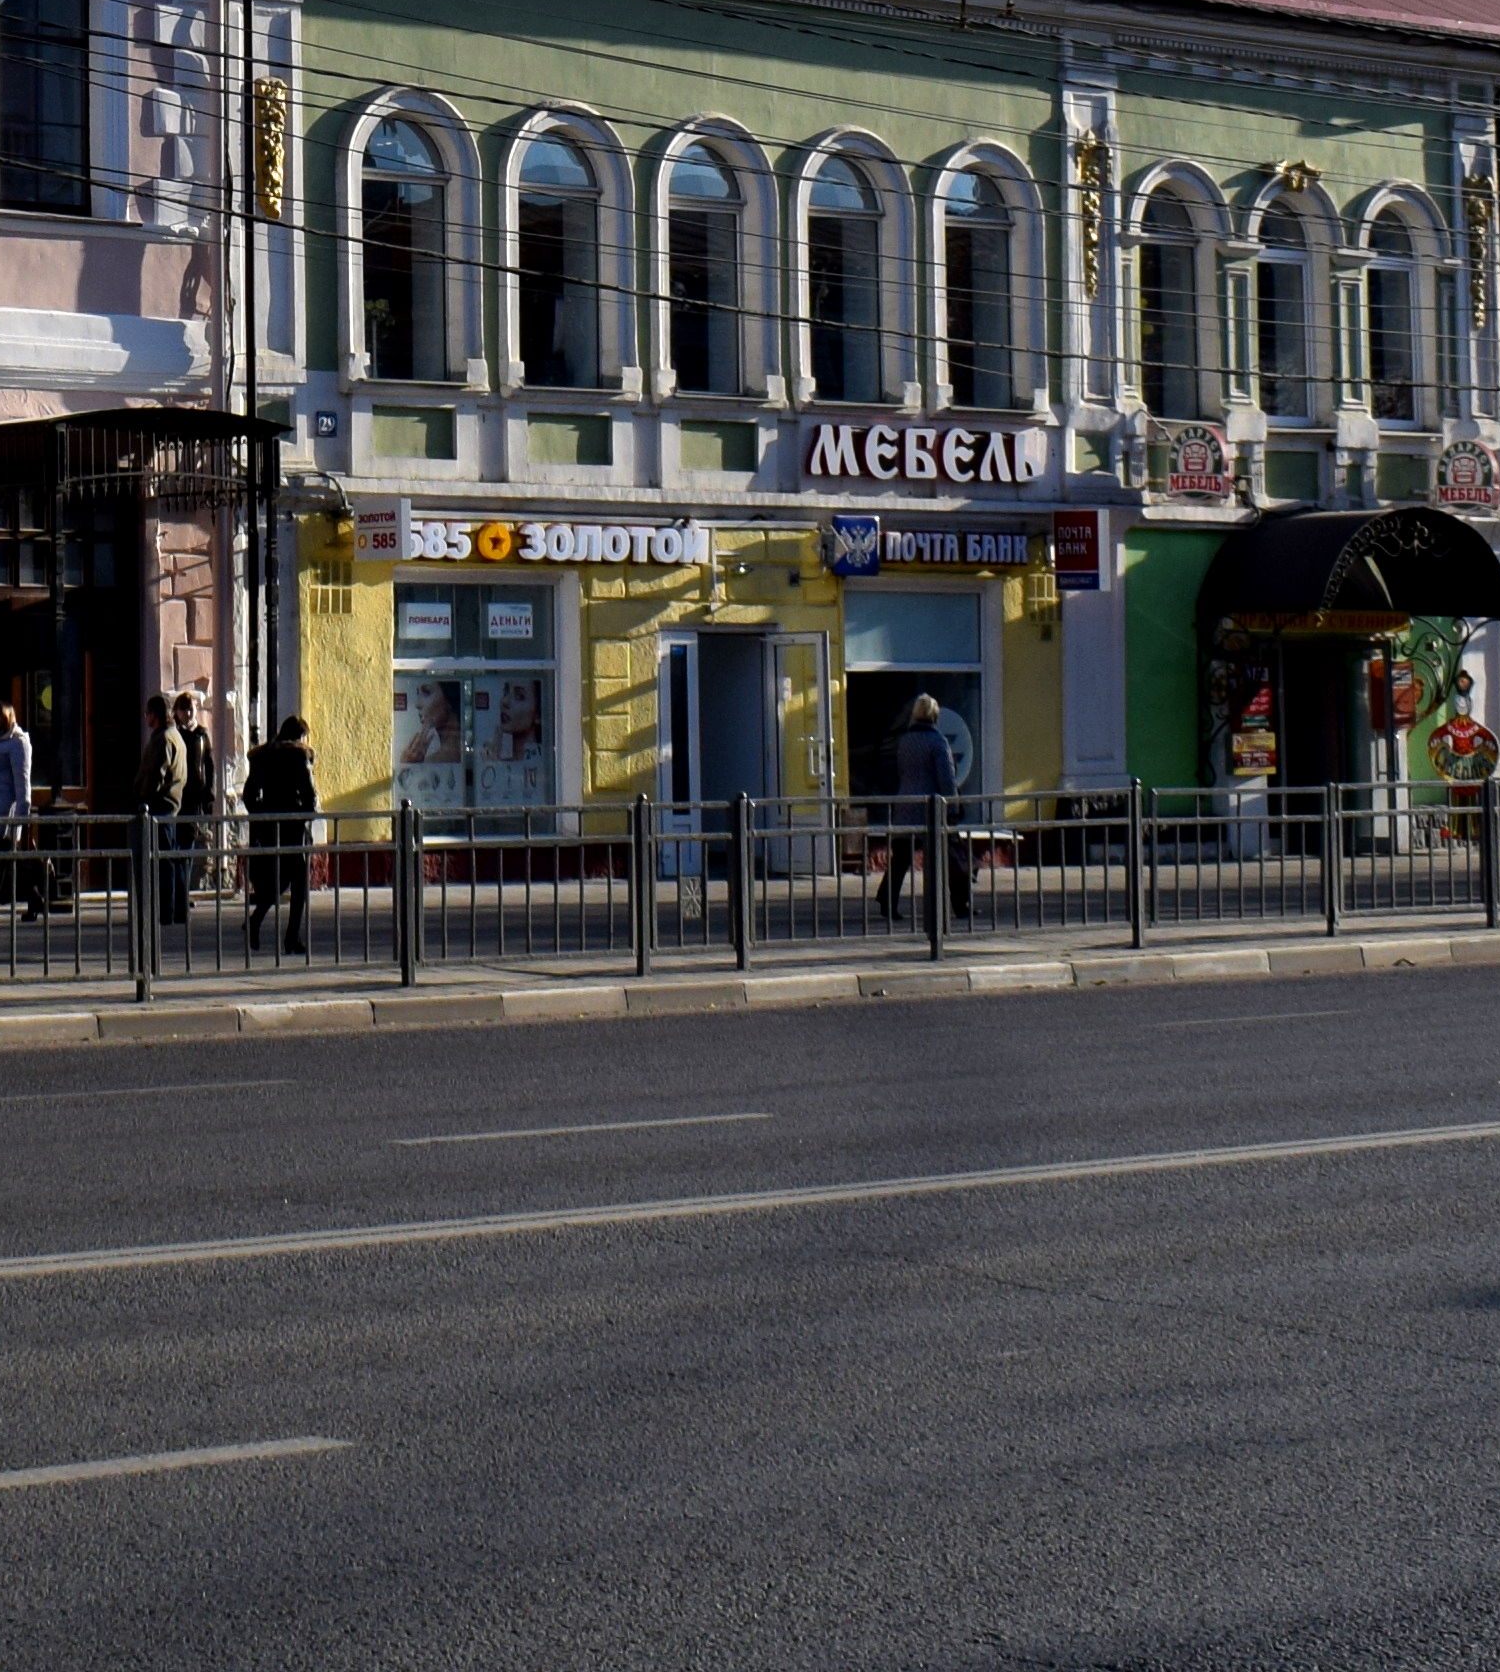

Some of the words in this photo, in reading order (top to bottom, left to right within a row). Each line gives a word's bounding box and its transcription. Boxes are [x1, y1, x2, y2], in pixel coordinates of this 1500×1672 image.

[809, 423, 1048, 483] МЕБЕЛЬ
[1169, 475, 1222, 491] МЕБЕЛЬ
[1438, 487, 1492, 504] МЕБЕЛЬ
[358, 510, 396, 524] ЗОЛОТОЙ
[372, 532, 397, 550] 585
[1057, 526, 1092, 540] ПОЧТА
[518, 519, 710, 565] ЗОЛОТОЙ
[885, 530, 960, 563] ПОЧТА
[966, 532, 1028, 564] БАНК
[1058, 542, 1088, 556] БАНК
[408, 616, 450, 626] ЛОМБАРД
[490, 615, 531, 627] ДЕНЬГИ
